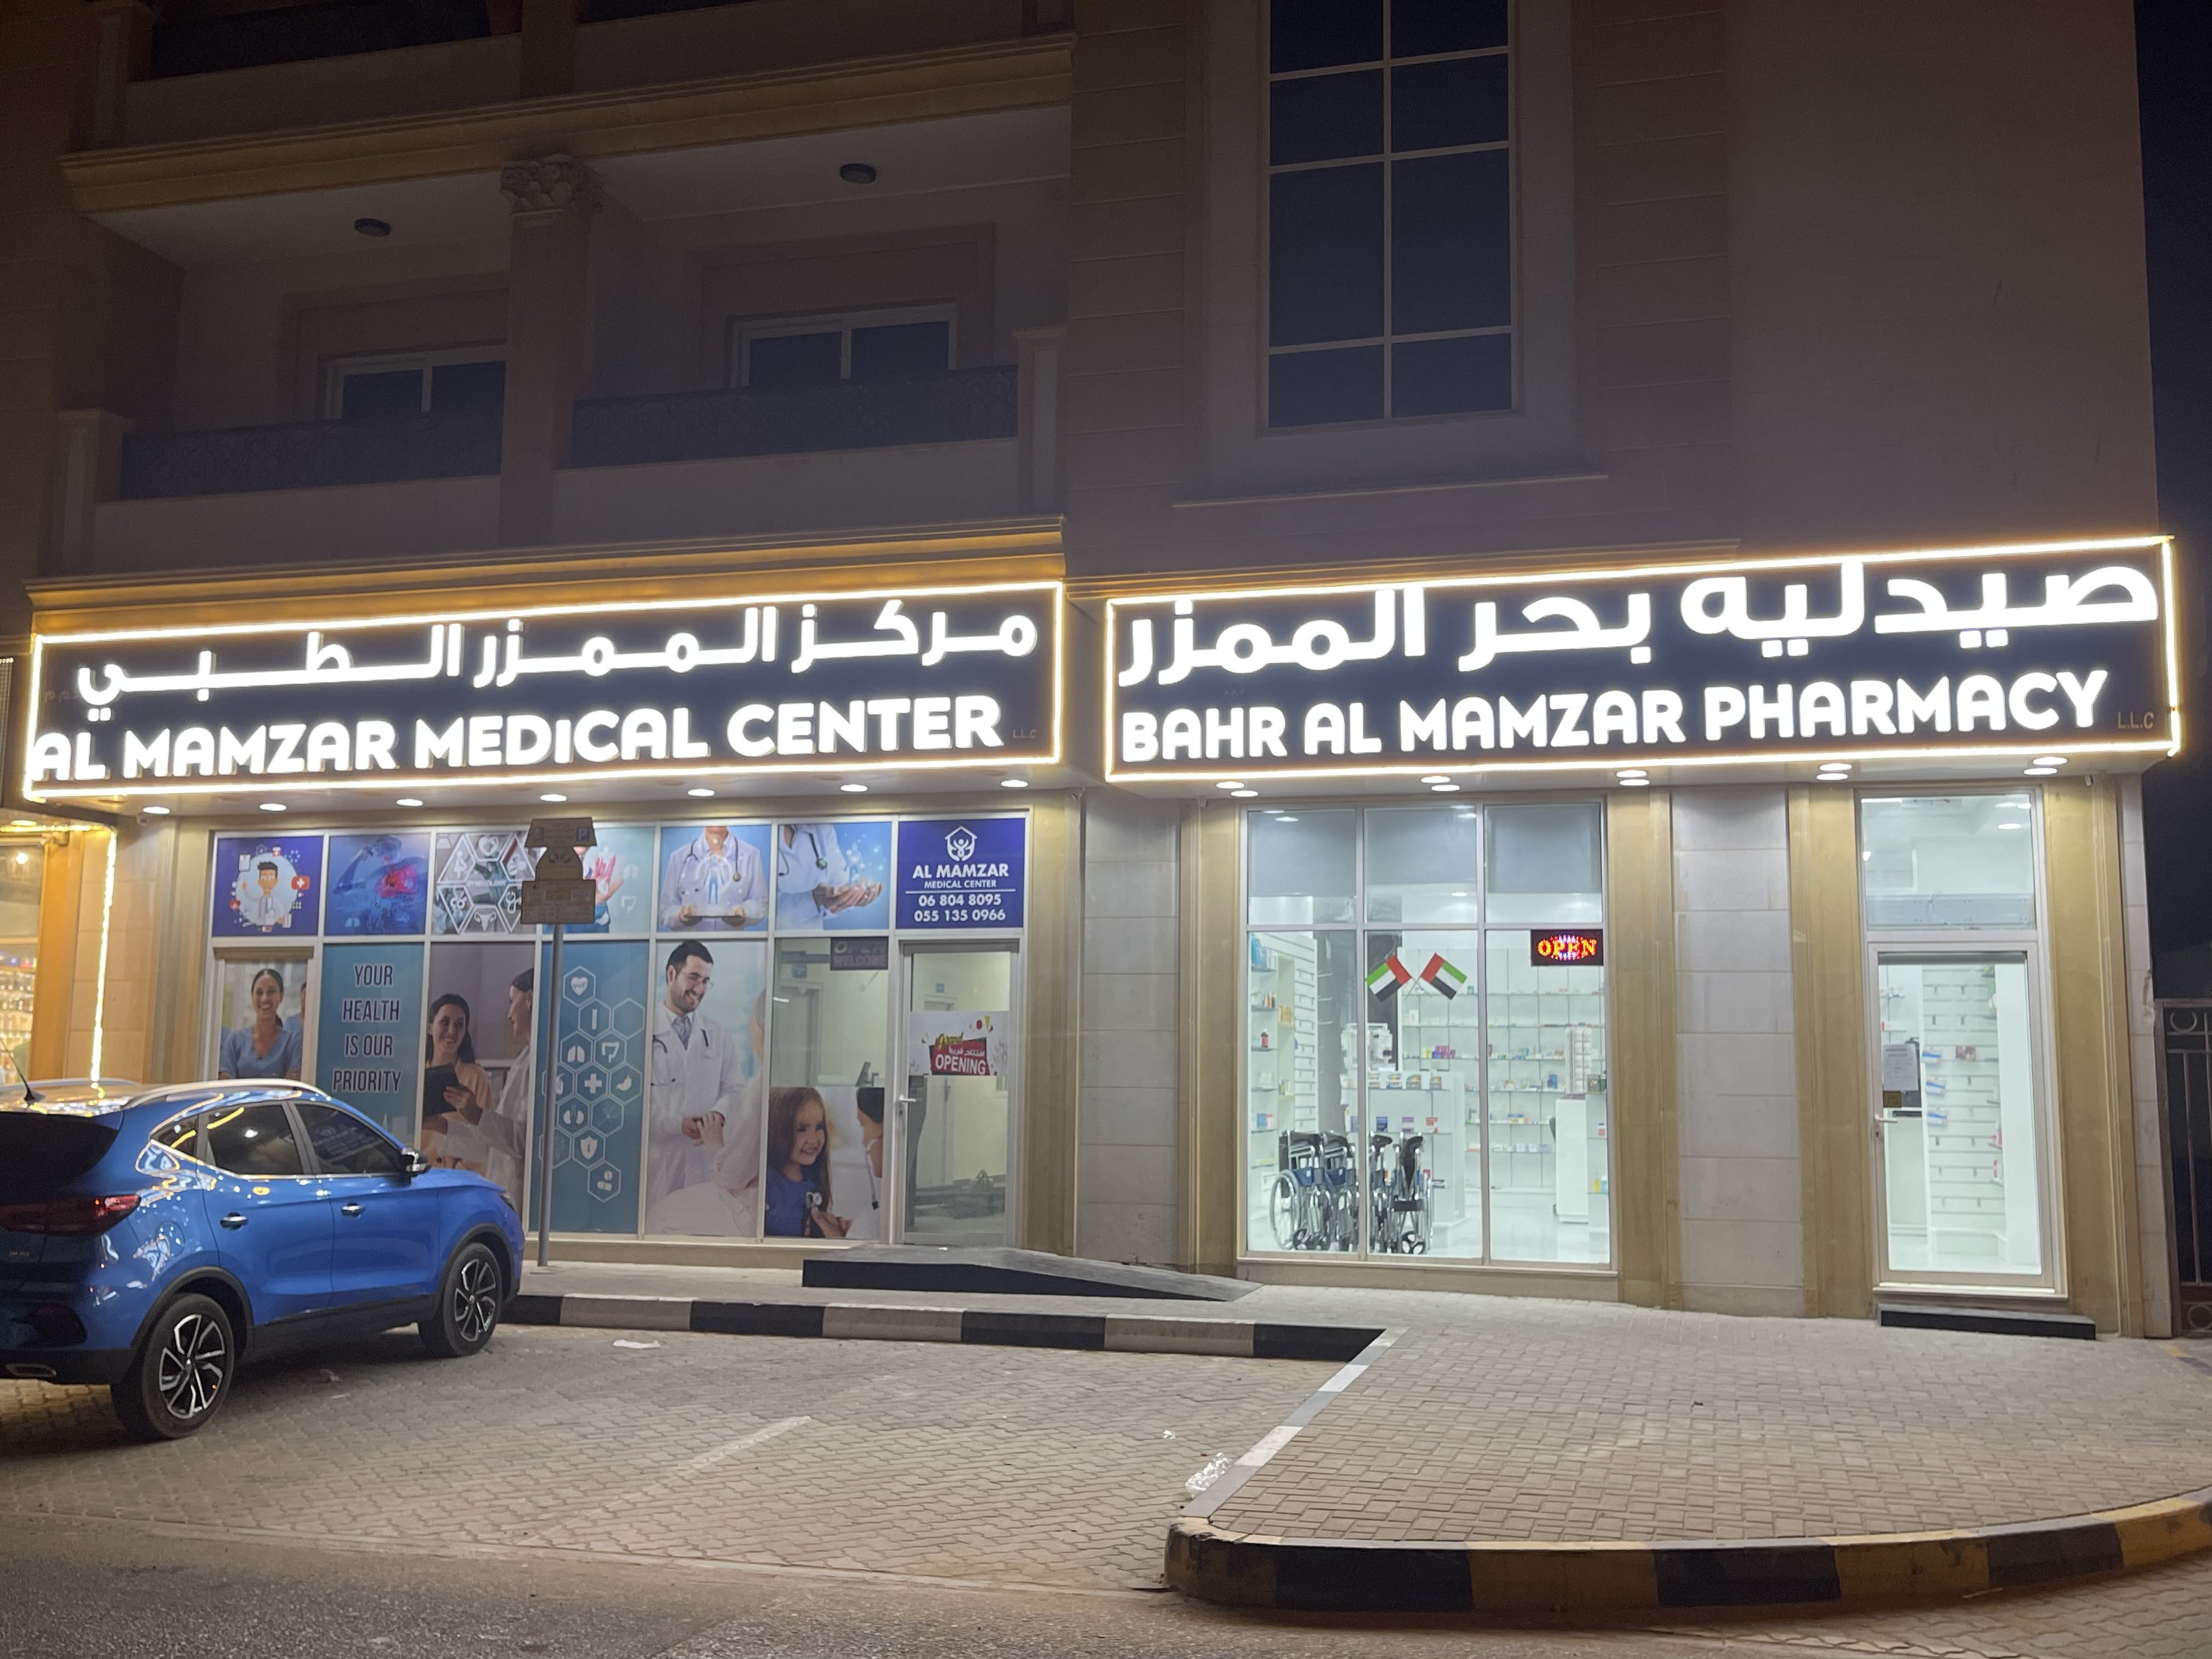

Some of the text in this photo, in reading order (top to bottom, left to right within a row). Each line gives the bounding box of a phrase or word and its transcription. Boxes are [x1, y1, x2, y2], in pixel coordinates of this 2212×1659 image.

[1119, 587, 1426, 686] الممزر
[1458, 592, 1651, 672] بحر
[77, 599, 1037, 721] مركز الممزر الطبي
[1121, 669, 2154, 763] BAHR AL MAMZAR PHARMACY L.L.C
[32, 732, 107, 781] AL
[122, 721, 400, 778] MAMZAR
[415, 707, 710, 769] MEDICAL
[727, 695, 1004, 756] CENTER
[578, 828, 588, 840] P
[912, 863, 1009, 879] AL MAMZAR
[924, 879, 996, 889] MEDICAL CENTER
[918, 894, 1001, 906] 06 804 8095
[914, 909, 1006, 922] 055 135 0966
[1537, 939, 1597, 956] OPEN
[354, 964, 393, 986] YOUR
[342, 999, 400, 1022] HEALTH
[345, 1035, 393, 1057] IS OUR
[935, 1054, 986, 1075] OPENING
[333, 1070, 402, 1092] PRIORITY
